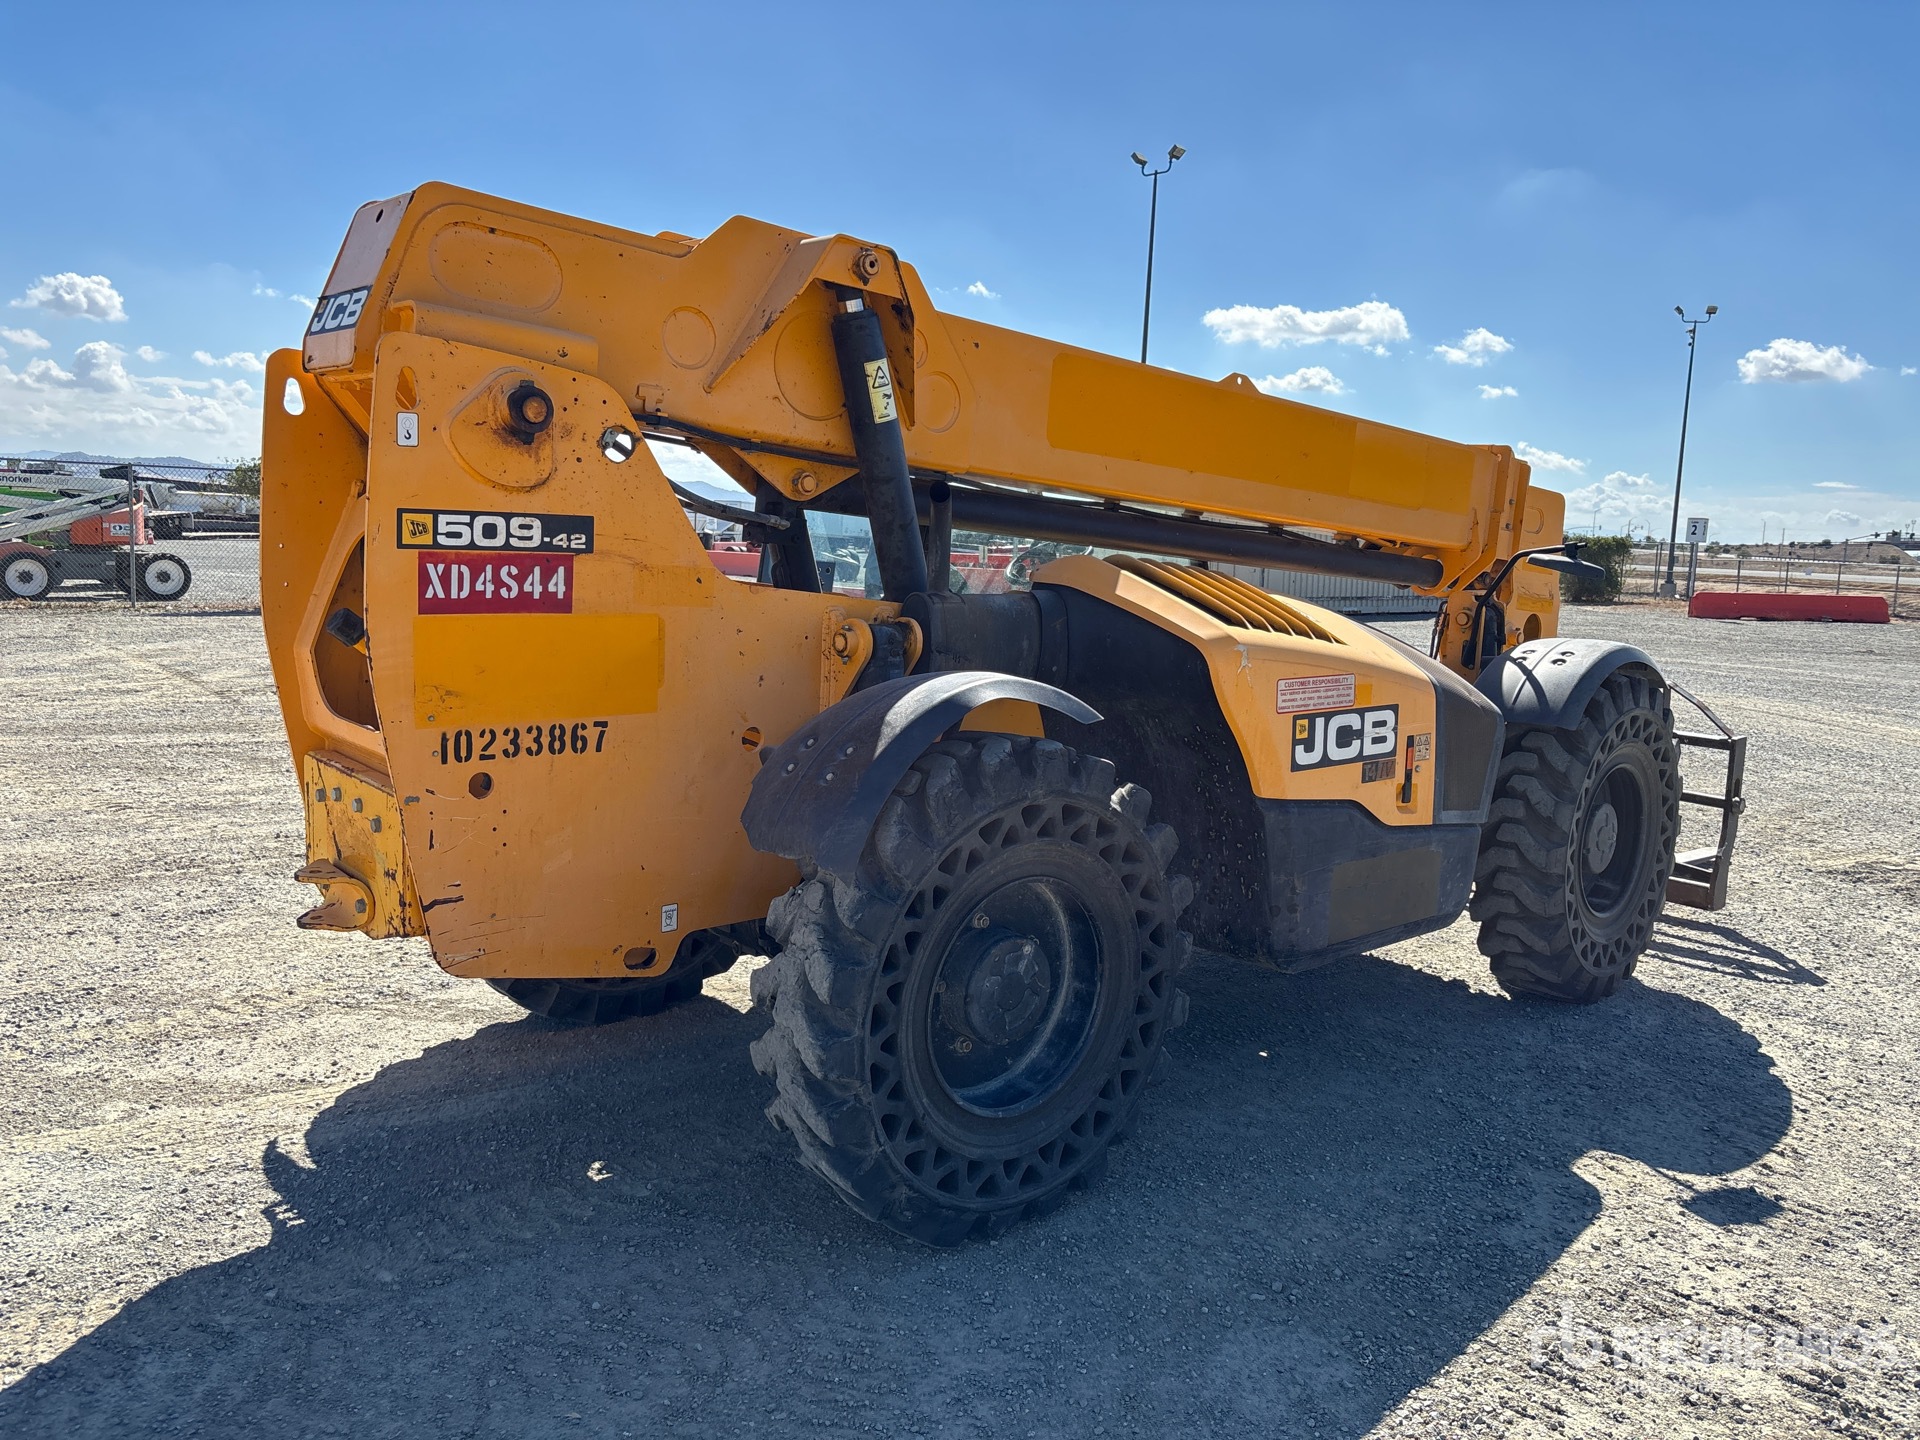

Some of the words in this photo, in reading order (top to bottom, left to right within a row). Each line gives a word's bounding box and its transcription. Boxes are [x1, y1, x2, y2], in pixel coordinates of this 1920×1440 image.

[311, 290, 368, 332] JCB
[411, 521, 427, 536] JCB
[437, 514, 586, 548] 509-42
[1691, 525, 1697, 535] 2
[425, 563, 565, 599] XD4S44
[1312, 677, 1349, 686] RESPONSIBILITY
[441, 721, 608, 765] 10233867
[1295, 710, 1395, 765] JCB
